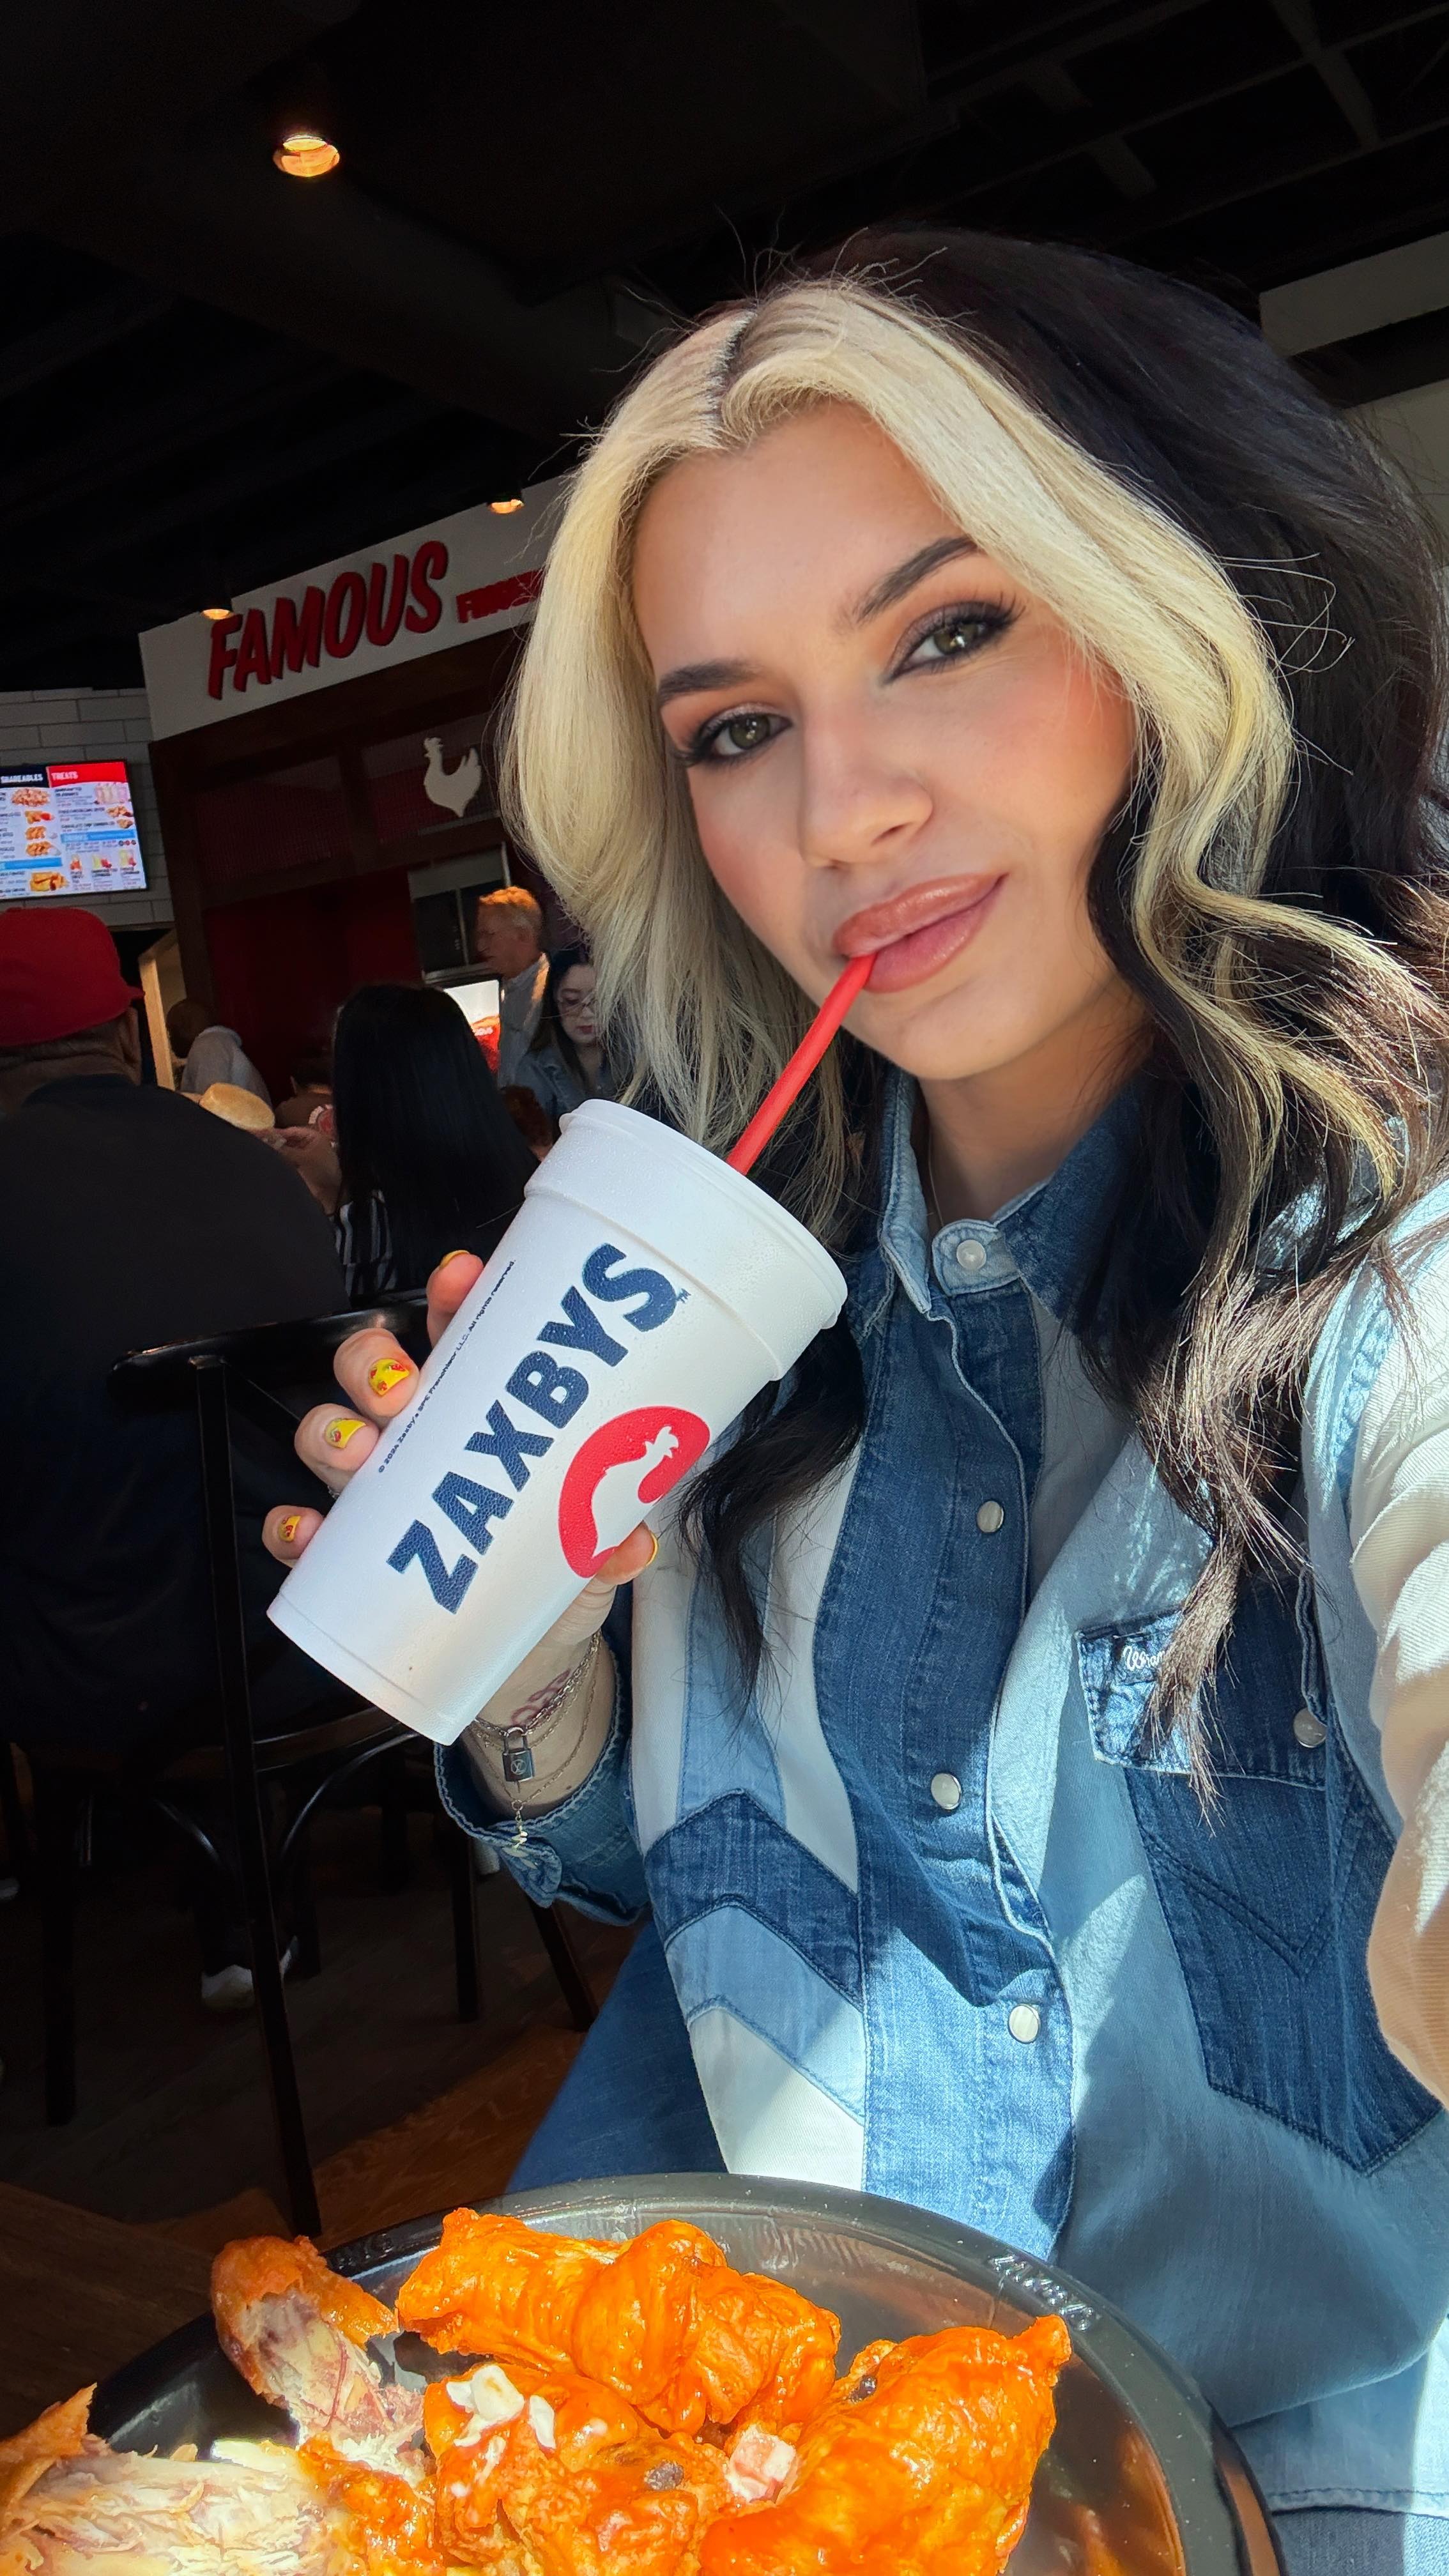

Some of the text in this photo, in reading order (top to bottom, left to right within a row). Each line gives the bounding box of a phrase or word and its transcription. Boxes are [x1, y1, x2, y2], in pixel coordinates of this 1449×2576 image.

[208, 540, 448, 700] FAMOUS
[51, 770, 79, 781] TREATS
[387, 1242, 678, 1614] ZAXBYS
